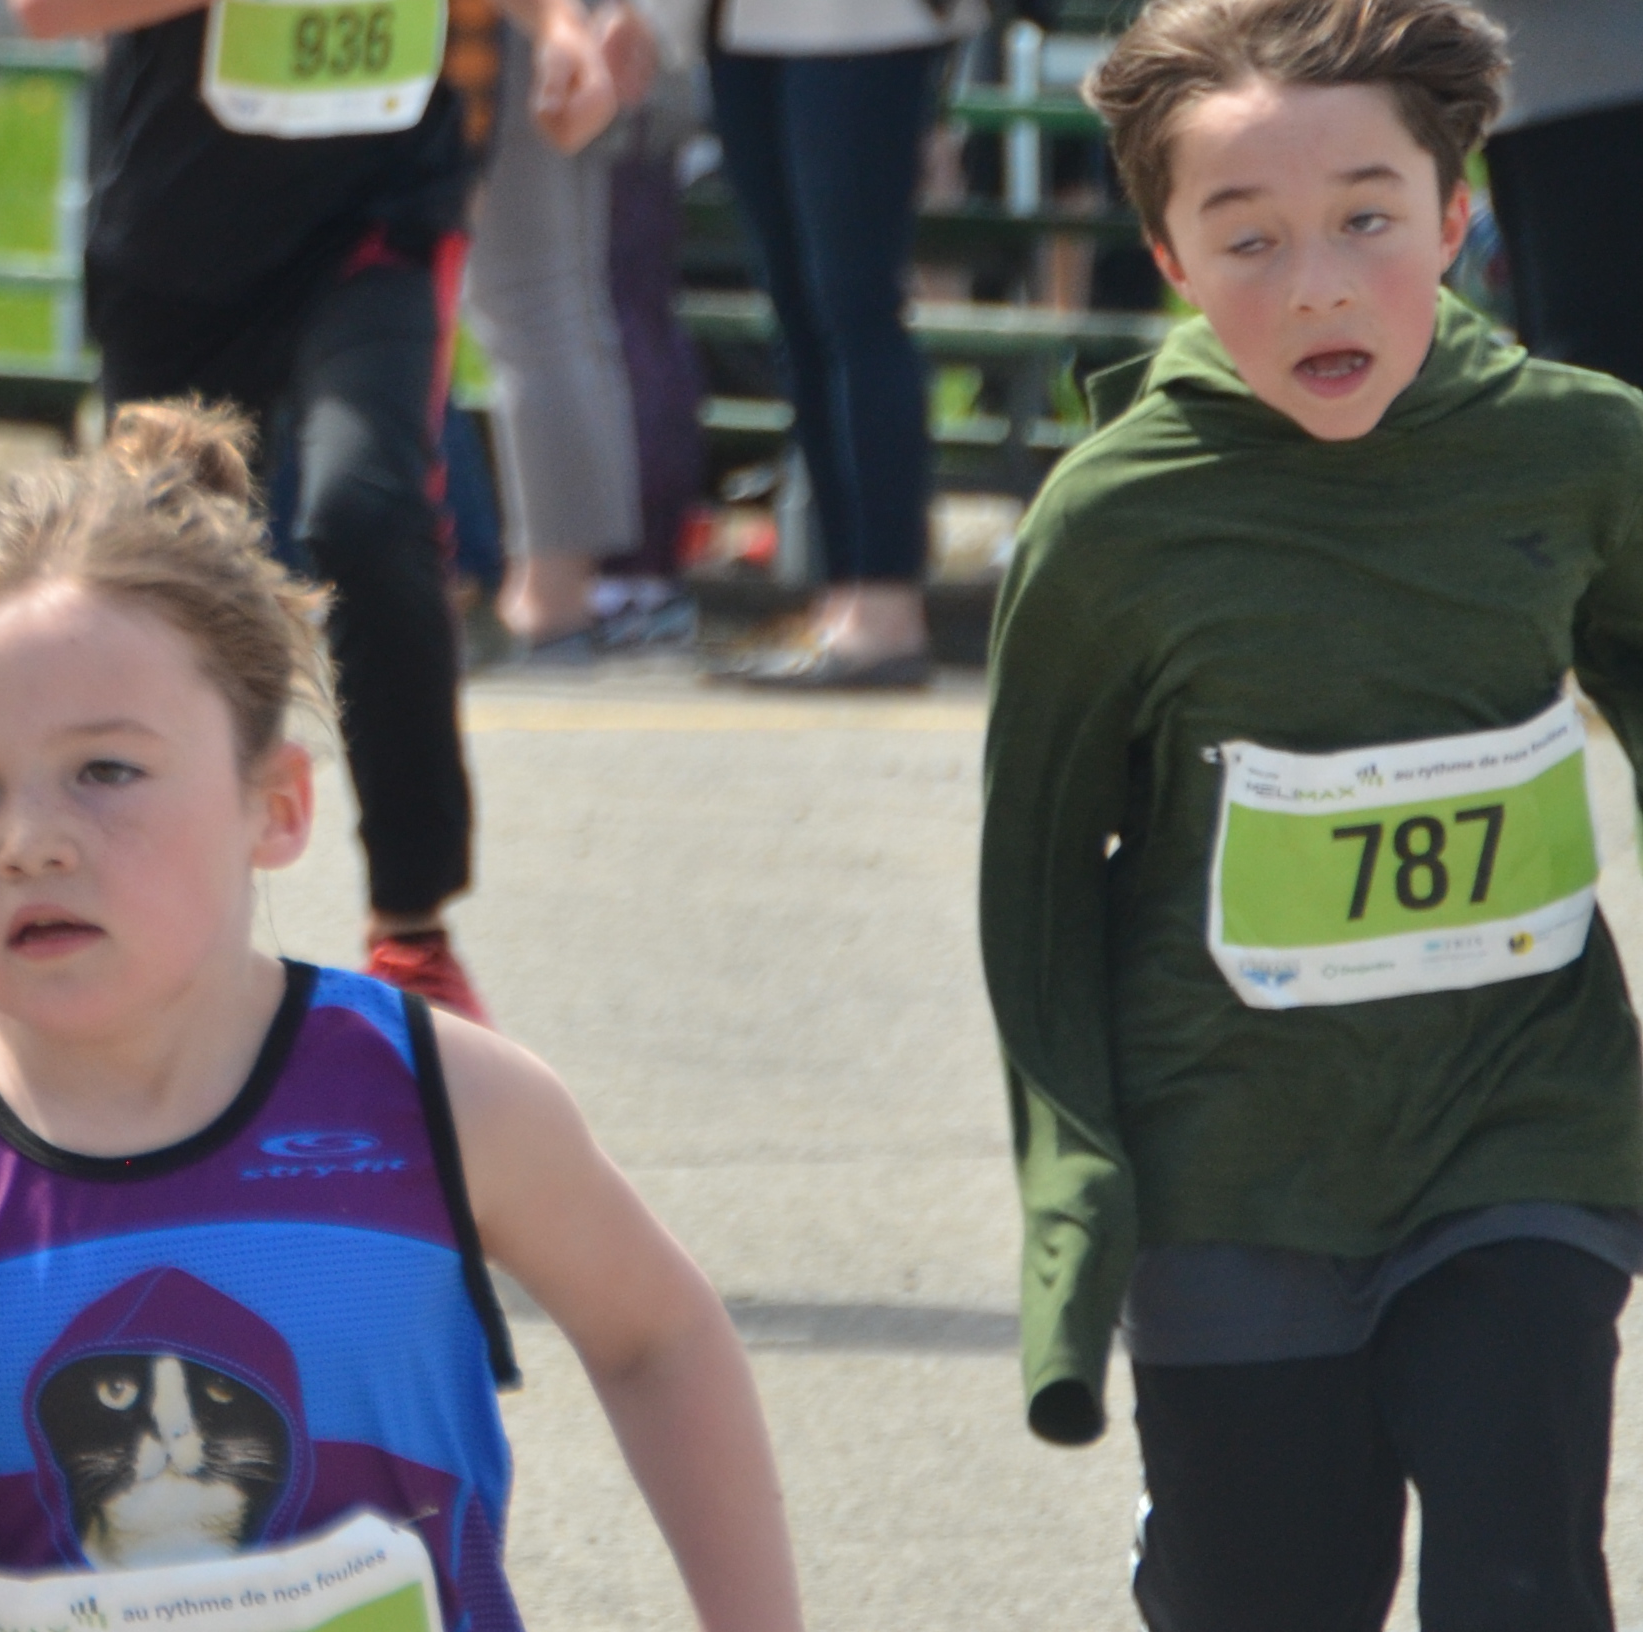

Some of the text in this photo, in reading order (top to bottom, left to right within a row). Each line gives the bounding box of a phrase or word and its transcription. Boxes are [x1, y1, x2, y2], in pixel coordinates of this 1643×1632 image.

[293, 2, 396, 82] 936
[1331, 804, 1505, 922] 787
[122, 1606, 149, 1624] au
[154, 1594, 234, 1623] rythme
[238, 1589, 268, 1609] de
[273, 1581, 313, 1603] nos
